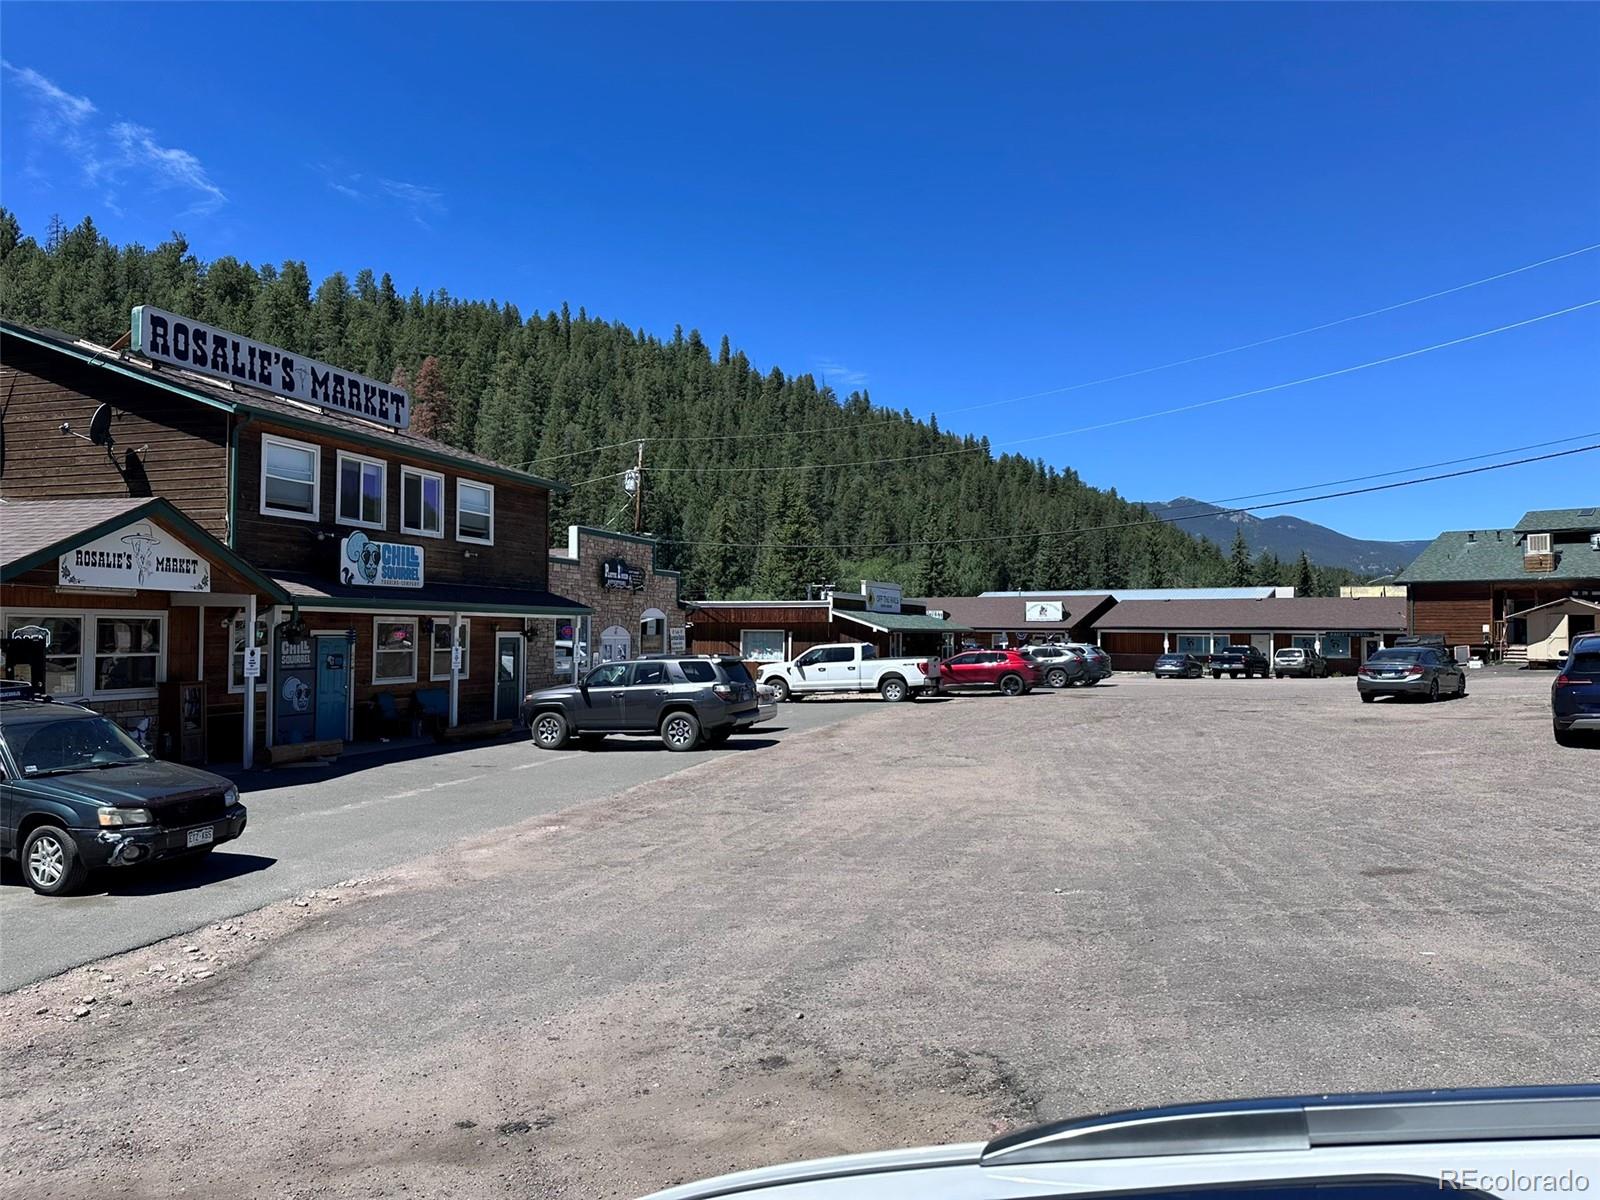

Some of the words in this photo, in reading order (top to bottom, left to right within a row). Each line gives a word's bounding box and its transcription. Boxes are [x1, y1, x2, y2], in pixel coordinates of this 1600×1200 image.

[149, 313, 295, 393] ROSALIE'S
[310, 365, 405, 424] MARKET
[75, 549, 133, 571] ROSALIE'S
[155, 556, 199, 575] MARKET
[381, 543, 420, 568] CHILL
[381, 565, 420, 581] SQUIRREL
[281, 640, 311, 655] CHILL
[281, 654, 311, 665] SQUIRREL
